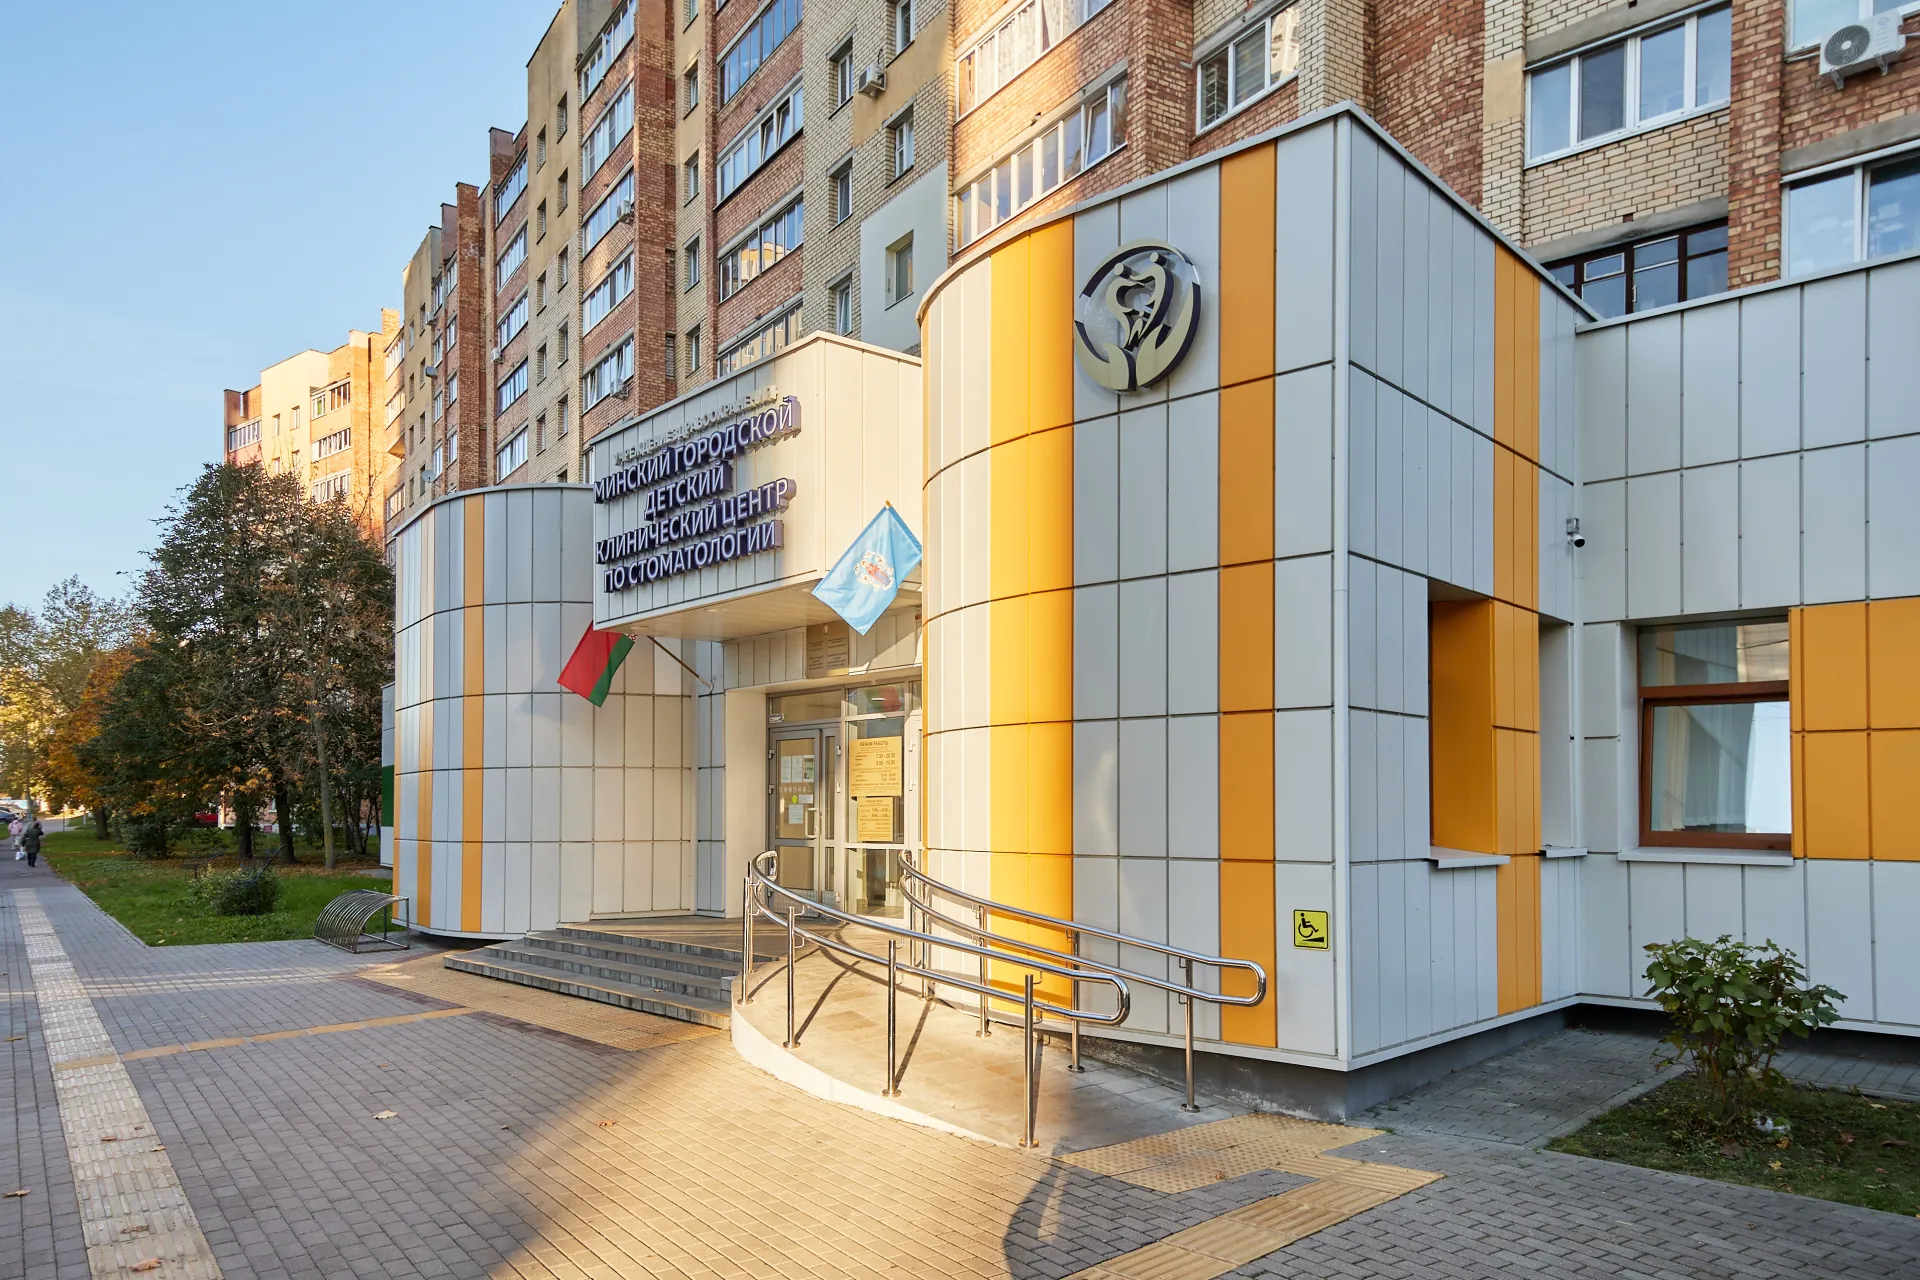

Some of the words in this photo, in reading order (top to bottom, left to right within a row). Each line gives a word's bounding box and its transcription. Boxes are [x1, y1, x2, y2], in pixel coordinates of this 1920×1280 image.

[594, 451, 671, 503] МИНСКИЙ
[674, 395, 799, 472] ГОРОДСКОЙ
[596, 501, 719, 564] КЛИНИЧЕСКИЙ
[722, 477, 796, 527] ЦЕНТР
[644, 459, 731, 521] ДЕТСКИЙ
[603, 566, 627, 593] ПО
[628, 520, 783, 587] СТОМАТОЛОГИИ
